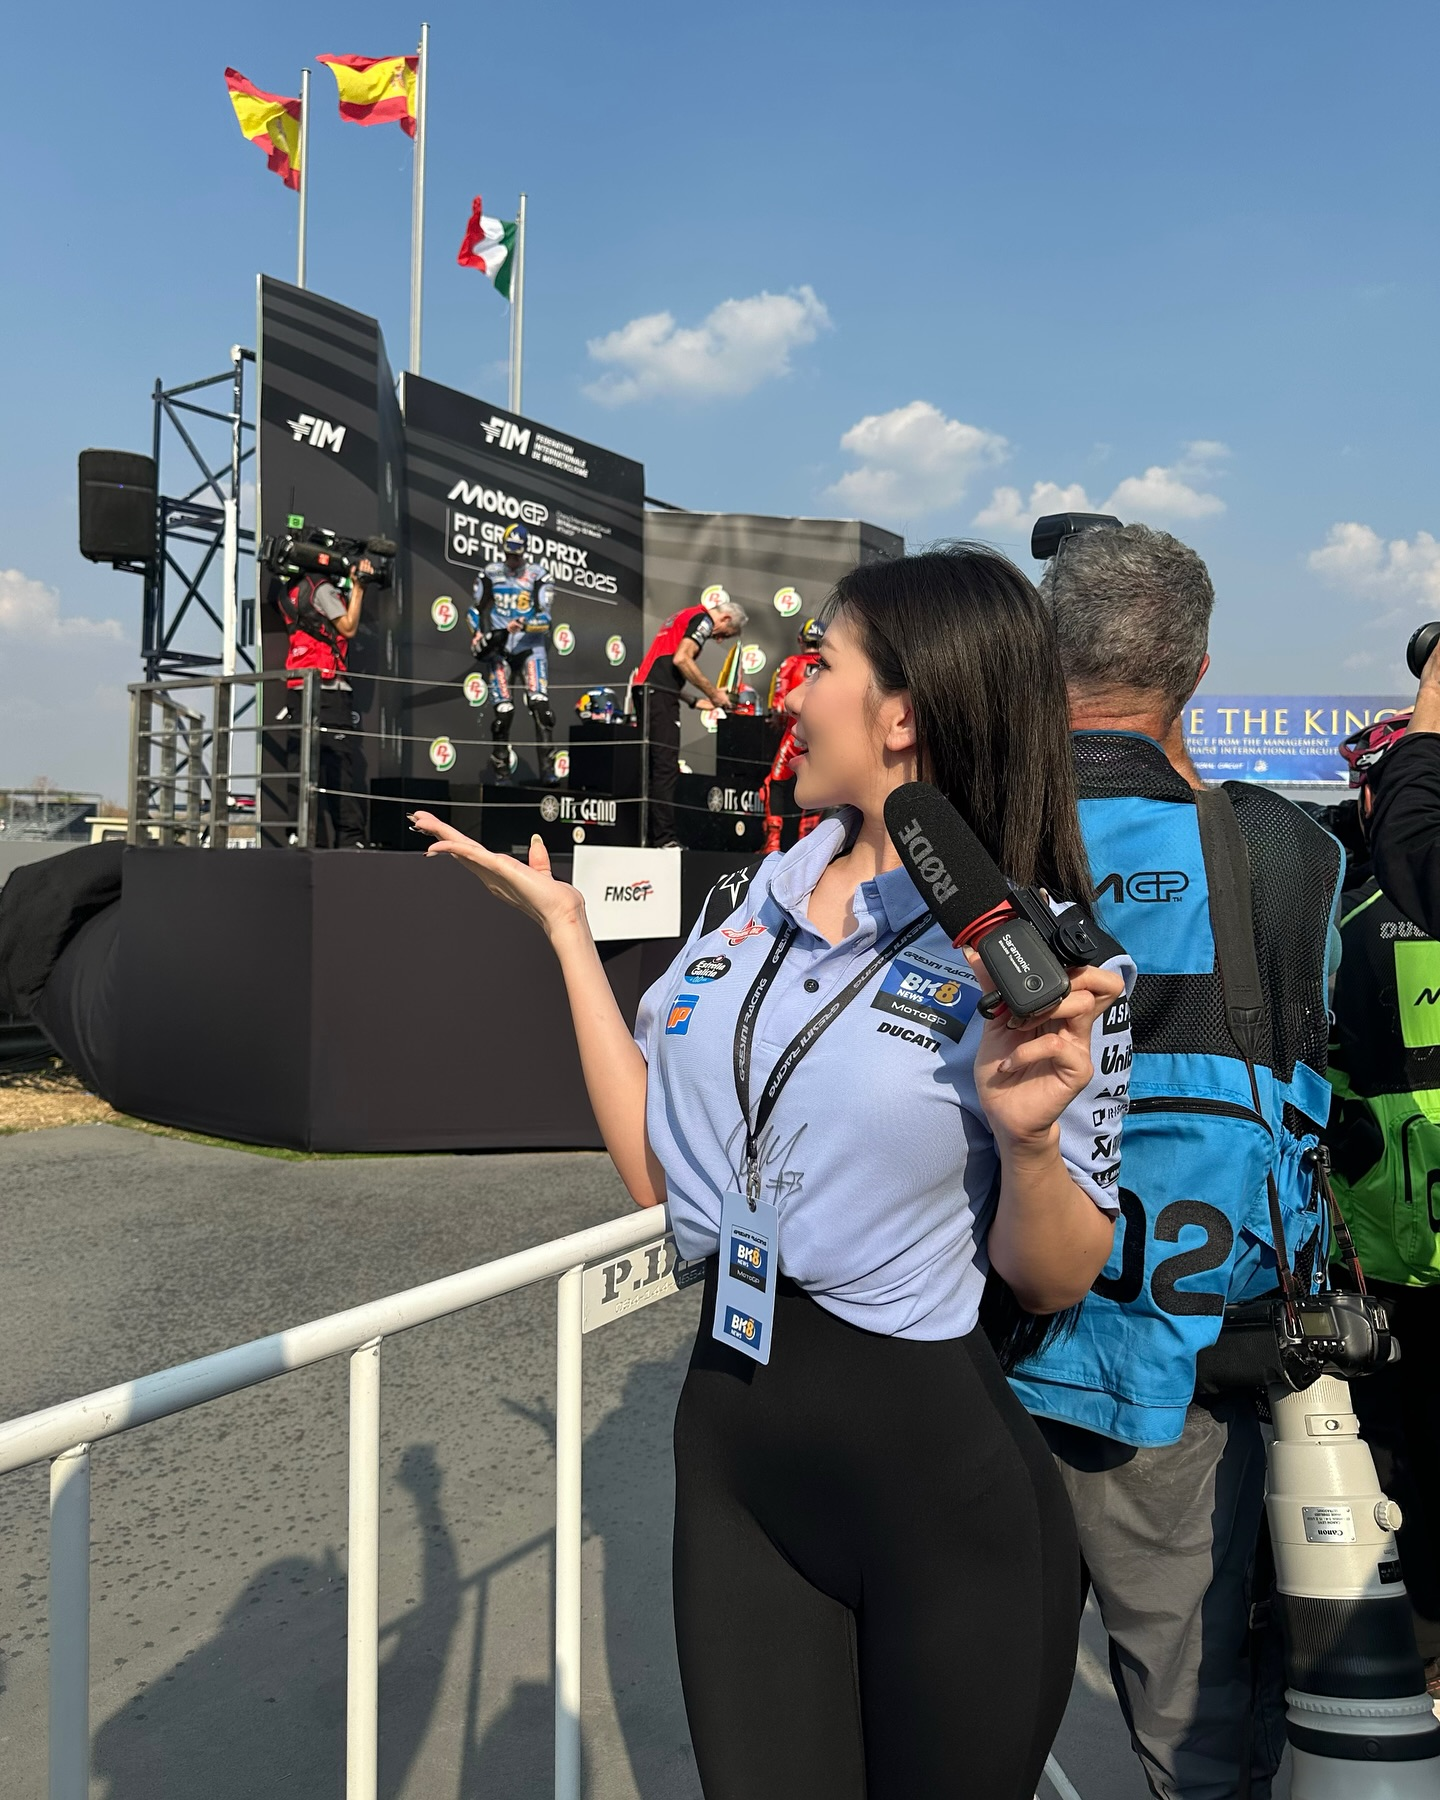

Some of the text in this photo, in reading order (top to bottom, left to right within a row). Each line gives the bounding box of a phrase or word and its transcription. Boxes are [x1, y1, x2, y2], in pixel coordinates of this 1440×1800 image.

[286, 413, 346, 453] FIM
[480, 415, 531, 455] FIM
[454, 512, 479, 536] PT
[481, 521, 544, 554] GRD
[547, 539, 588, 568] PRIX
[453, 534, 479, 556] OF
[574, 569, 617, 594] 2025
[1217, 708, 1288, 735] THE
[1212, 737, 1239, 746] FROM
[1243, 737, 1261, 746] THE
[1263, 737, 1330, 747] MANAGEMENT
[1221, 746, 1296, 755] INTERNATIONAL
[1299, 747, 1339, 756] CIRCUIT
[581, 799, 616, 822] GENIO
[898, 818, 959, 904] RØDE
[604, 885, 648, 901] FMSCT
[772, 926, 793, 964] GRESIN
[893, 913, 933, 950] GRESINI
[696, 960, 726, 971] Estrella
[903, 951, 942, 970] GRESINI
[1002, 933, 1030, 973] Saramonic
[691, 967, 718, 977] Galicia
[896, 988, 924, 1003] NEWS
[900, 971, 962, 1007] BK8
[667, 1007, 692, 1028] IP
[739, 978, 767, 1082] GRESINI RACING
[769, 1002, 840, 1098] GRESINI RACING
[877, 1021, 942, 1053] DUCATI
[737, 1243, 762, 1269] BK8
[737, 1259, 750, 1268] NEWS
[730, 1329, 743, 1339] NEWS
[731, 1313, 756, 1341] BK8
